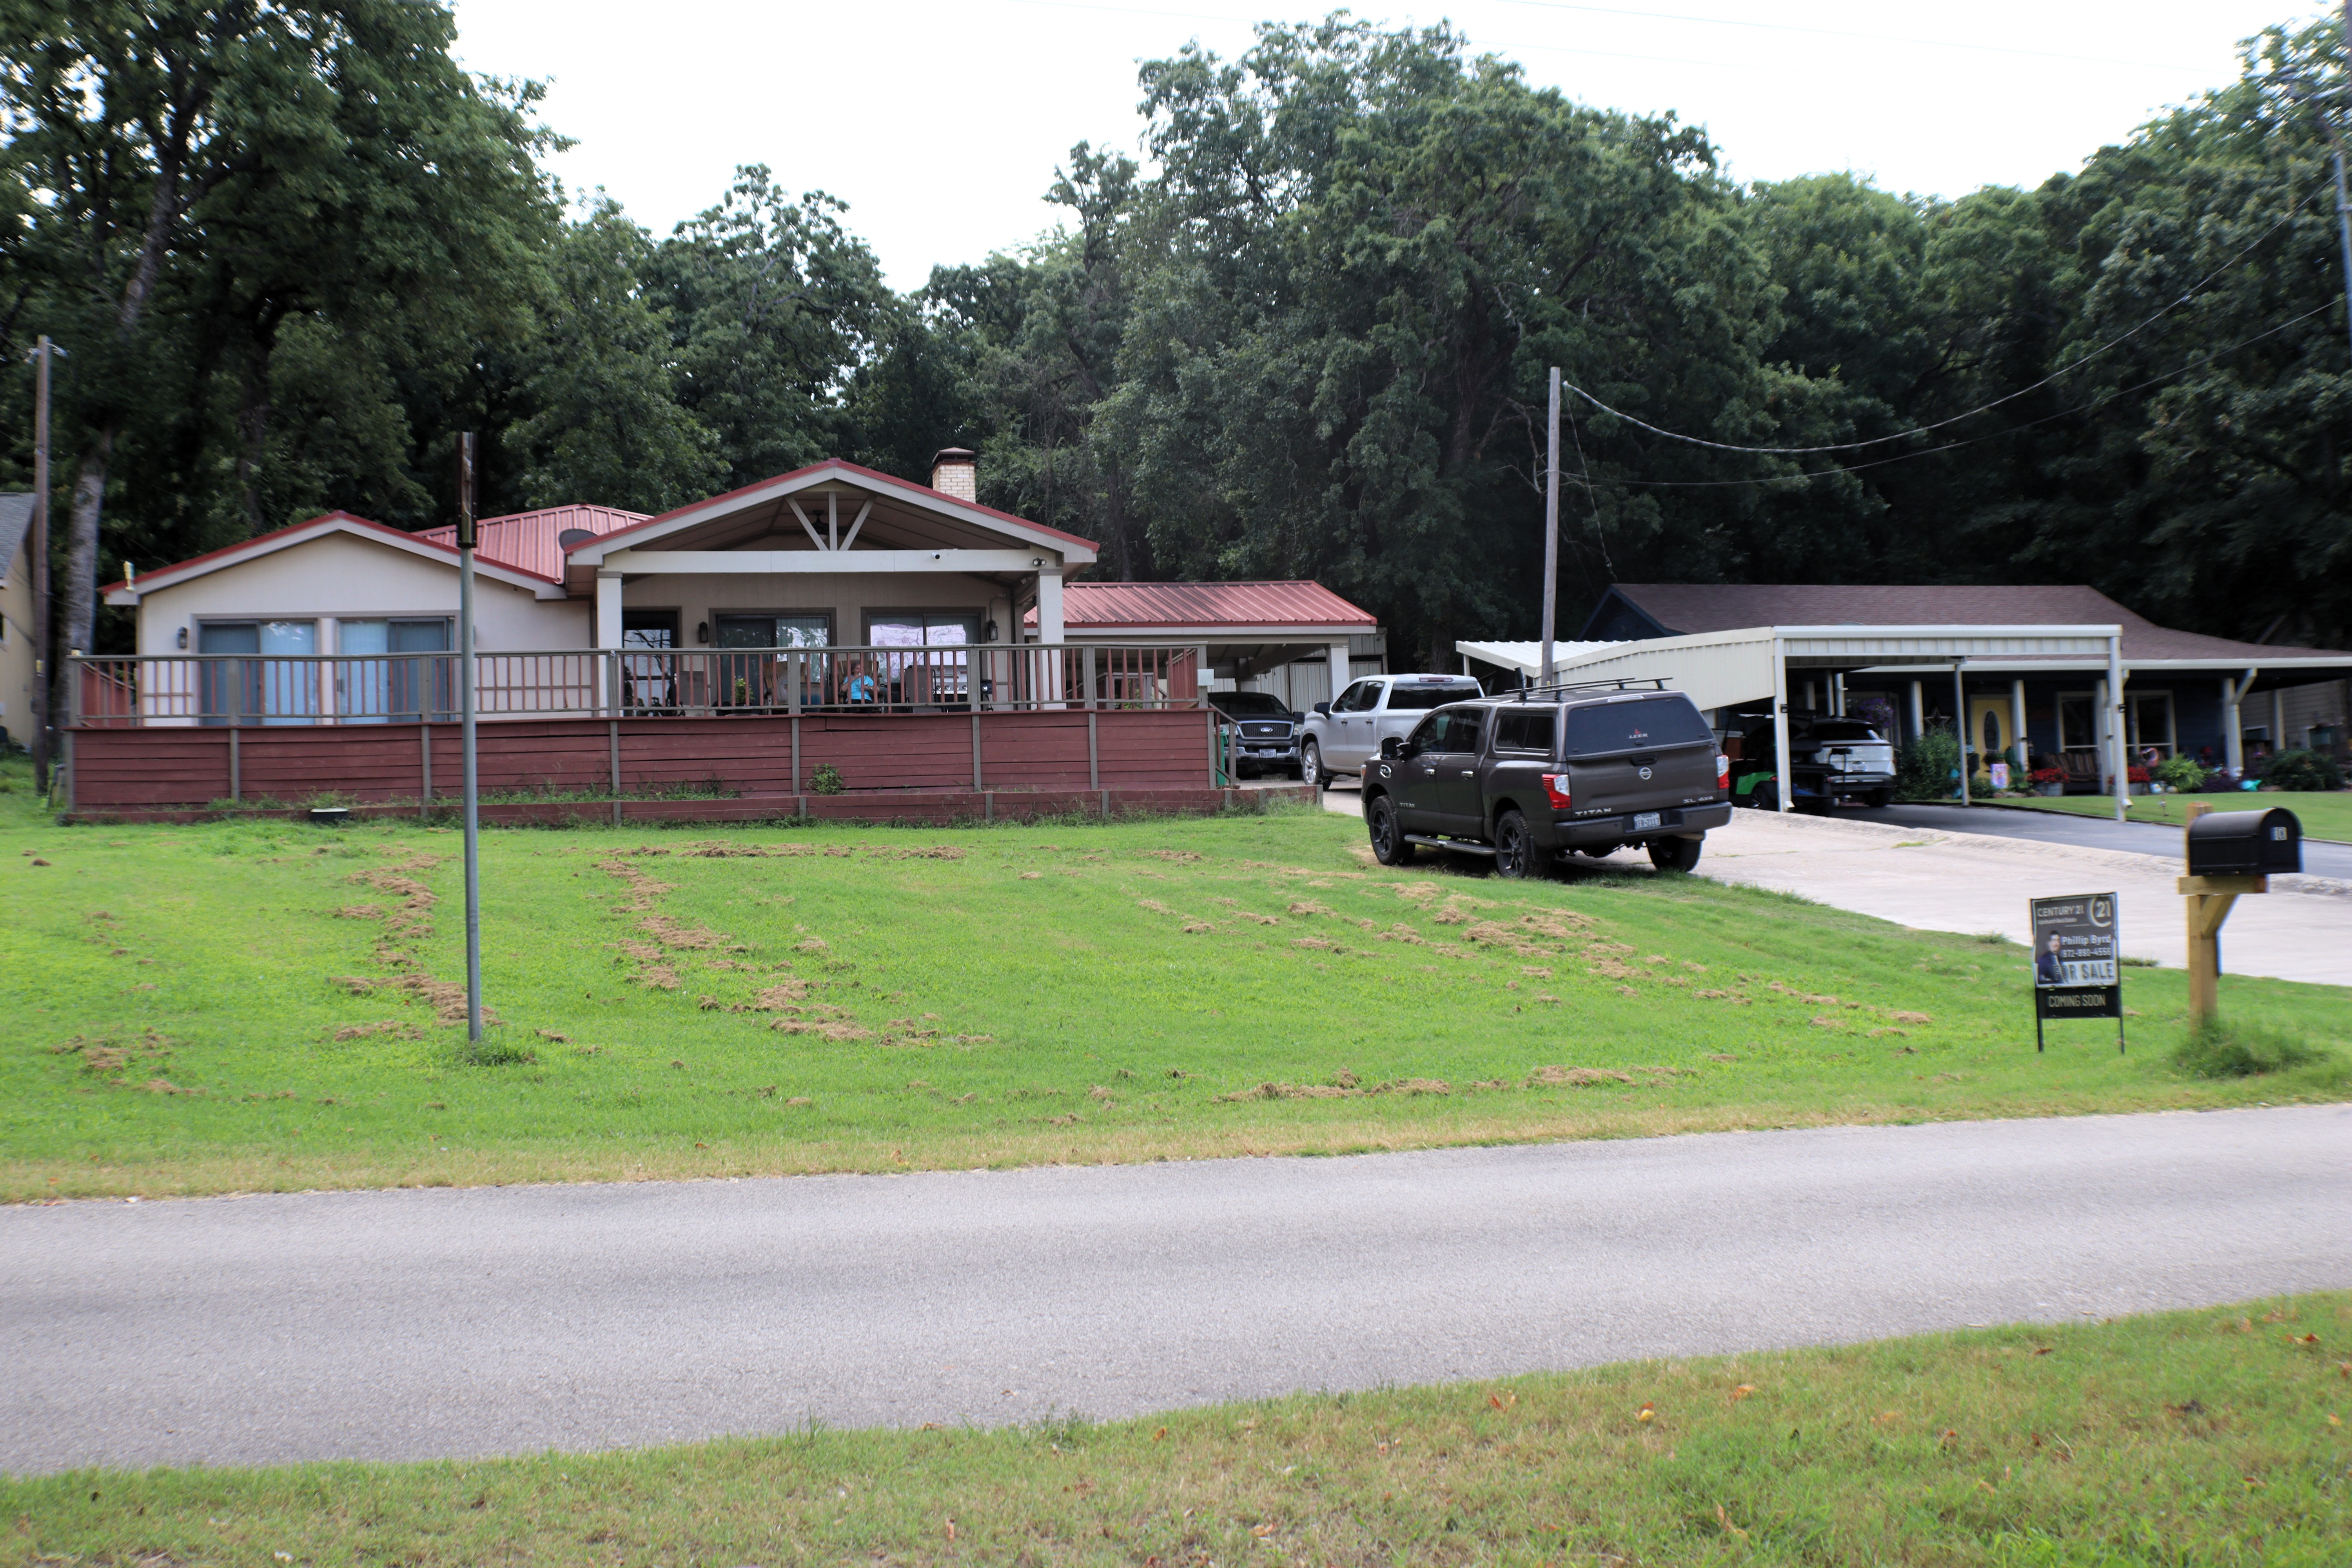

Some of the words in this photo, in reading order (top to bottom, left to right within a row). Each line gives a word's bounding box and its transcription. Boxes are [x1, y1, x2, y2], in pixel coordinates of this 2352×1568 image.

[1575, 808, 1612, 816] TITAN
[2038, 906, 2074, 917] CENTURY
[2076, 905, 2085, 914] 21
[2062, 935, 2089, 946] Phillip
[2090, 934, 2111, 945] Byrd
[2053, 964, 2077, 980] FOR
[2082, 963, 2114, 979] SALE
[2049, 995, 2080, 1007] COMING
[2082, 994, 2106, 1007] SOON
